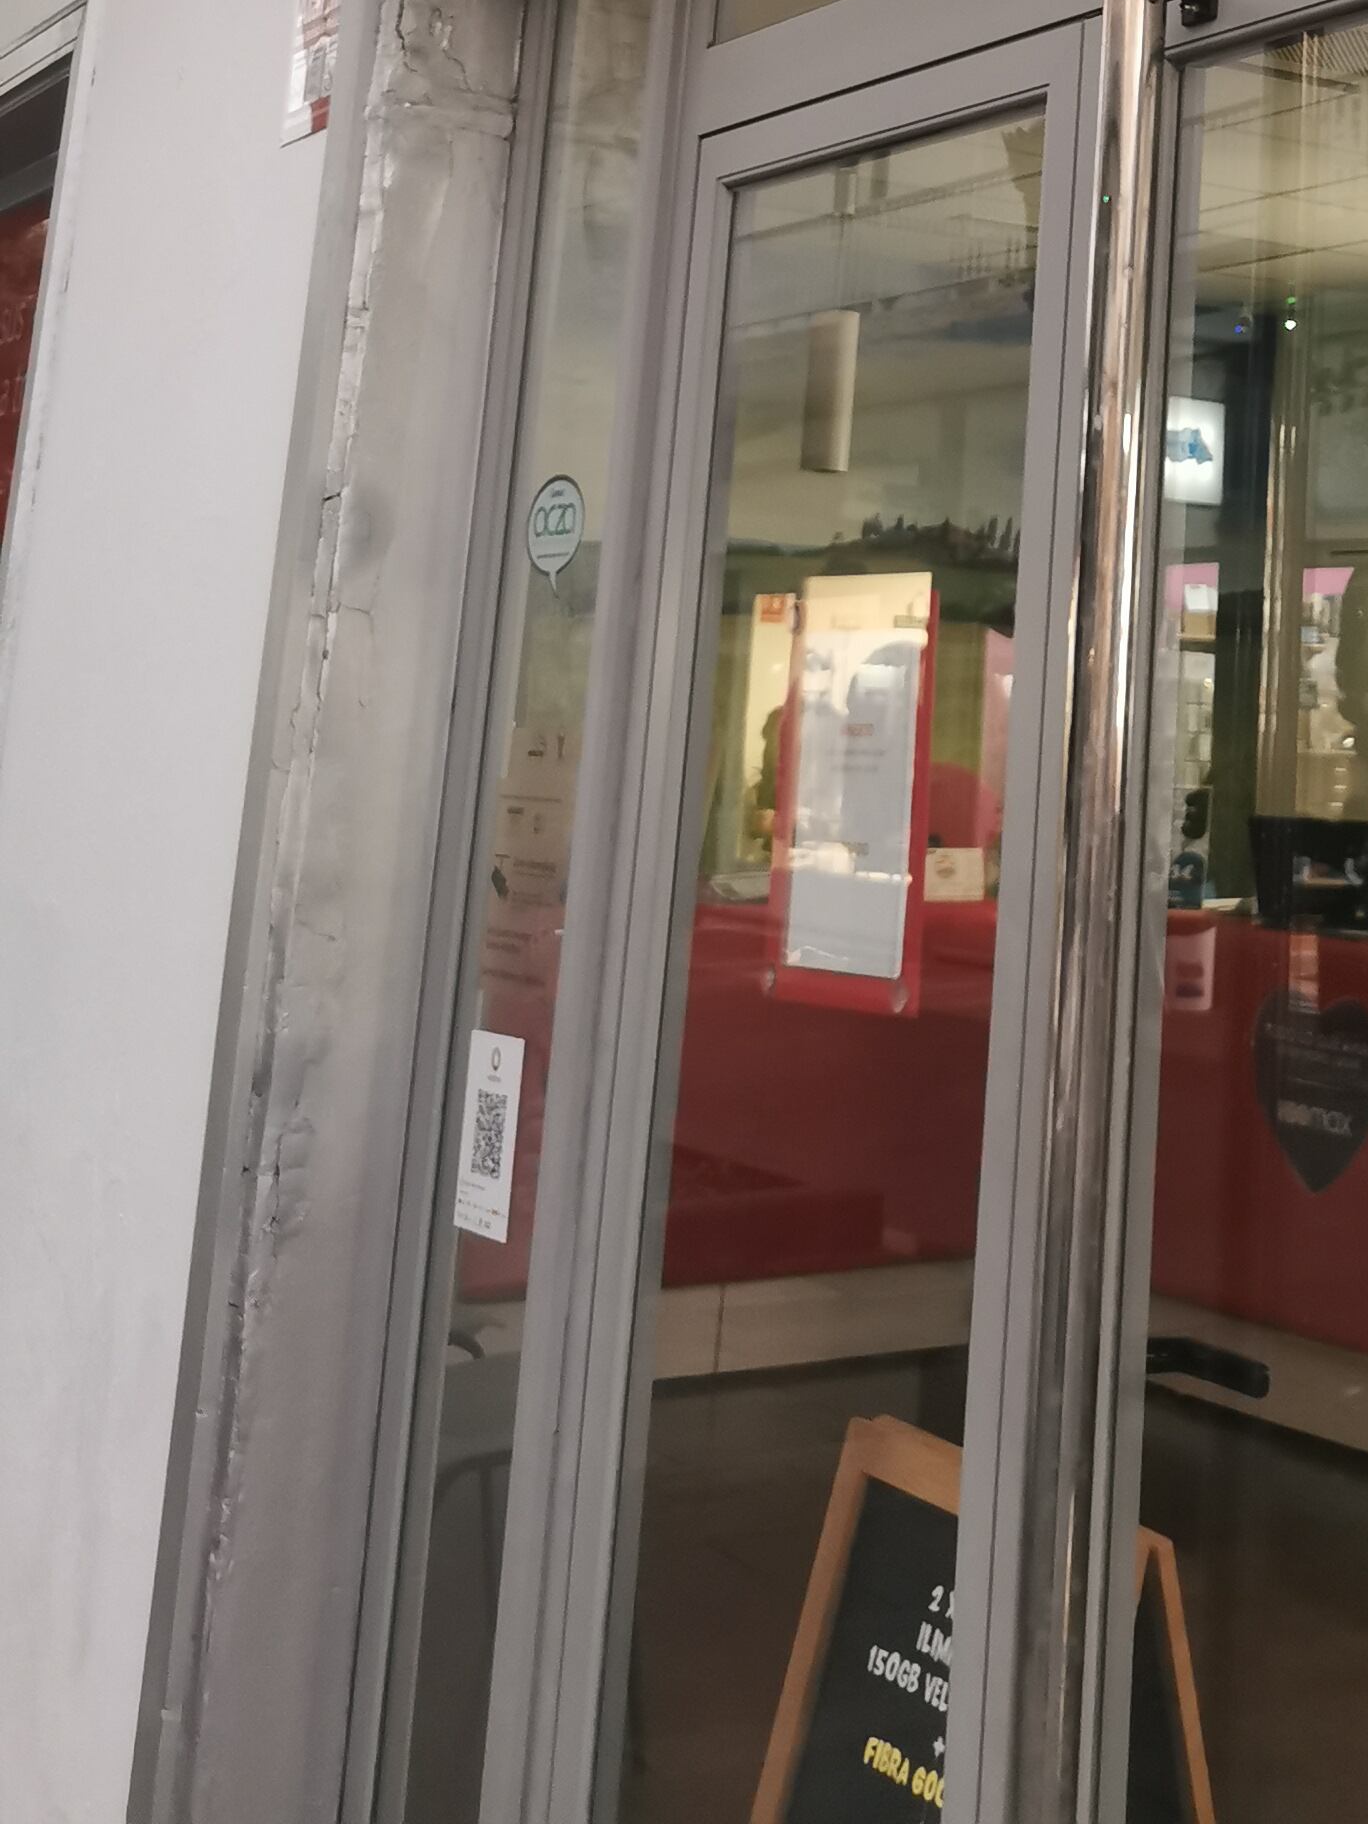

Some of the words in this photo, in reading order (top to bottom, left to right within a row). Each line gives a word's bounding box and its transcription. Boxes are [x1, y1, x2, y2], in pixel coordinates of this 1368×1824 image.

[928, 1585, 945, 1612] 2
[866, 1644, 922, 1693] 150GB
[863, 1736, 910, 1787] FIBRA
